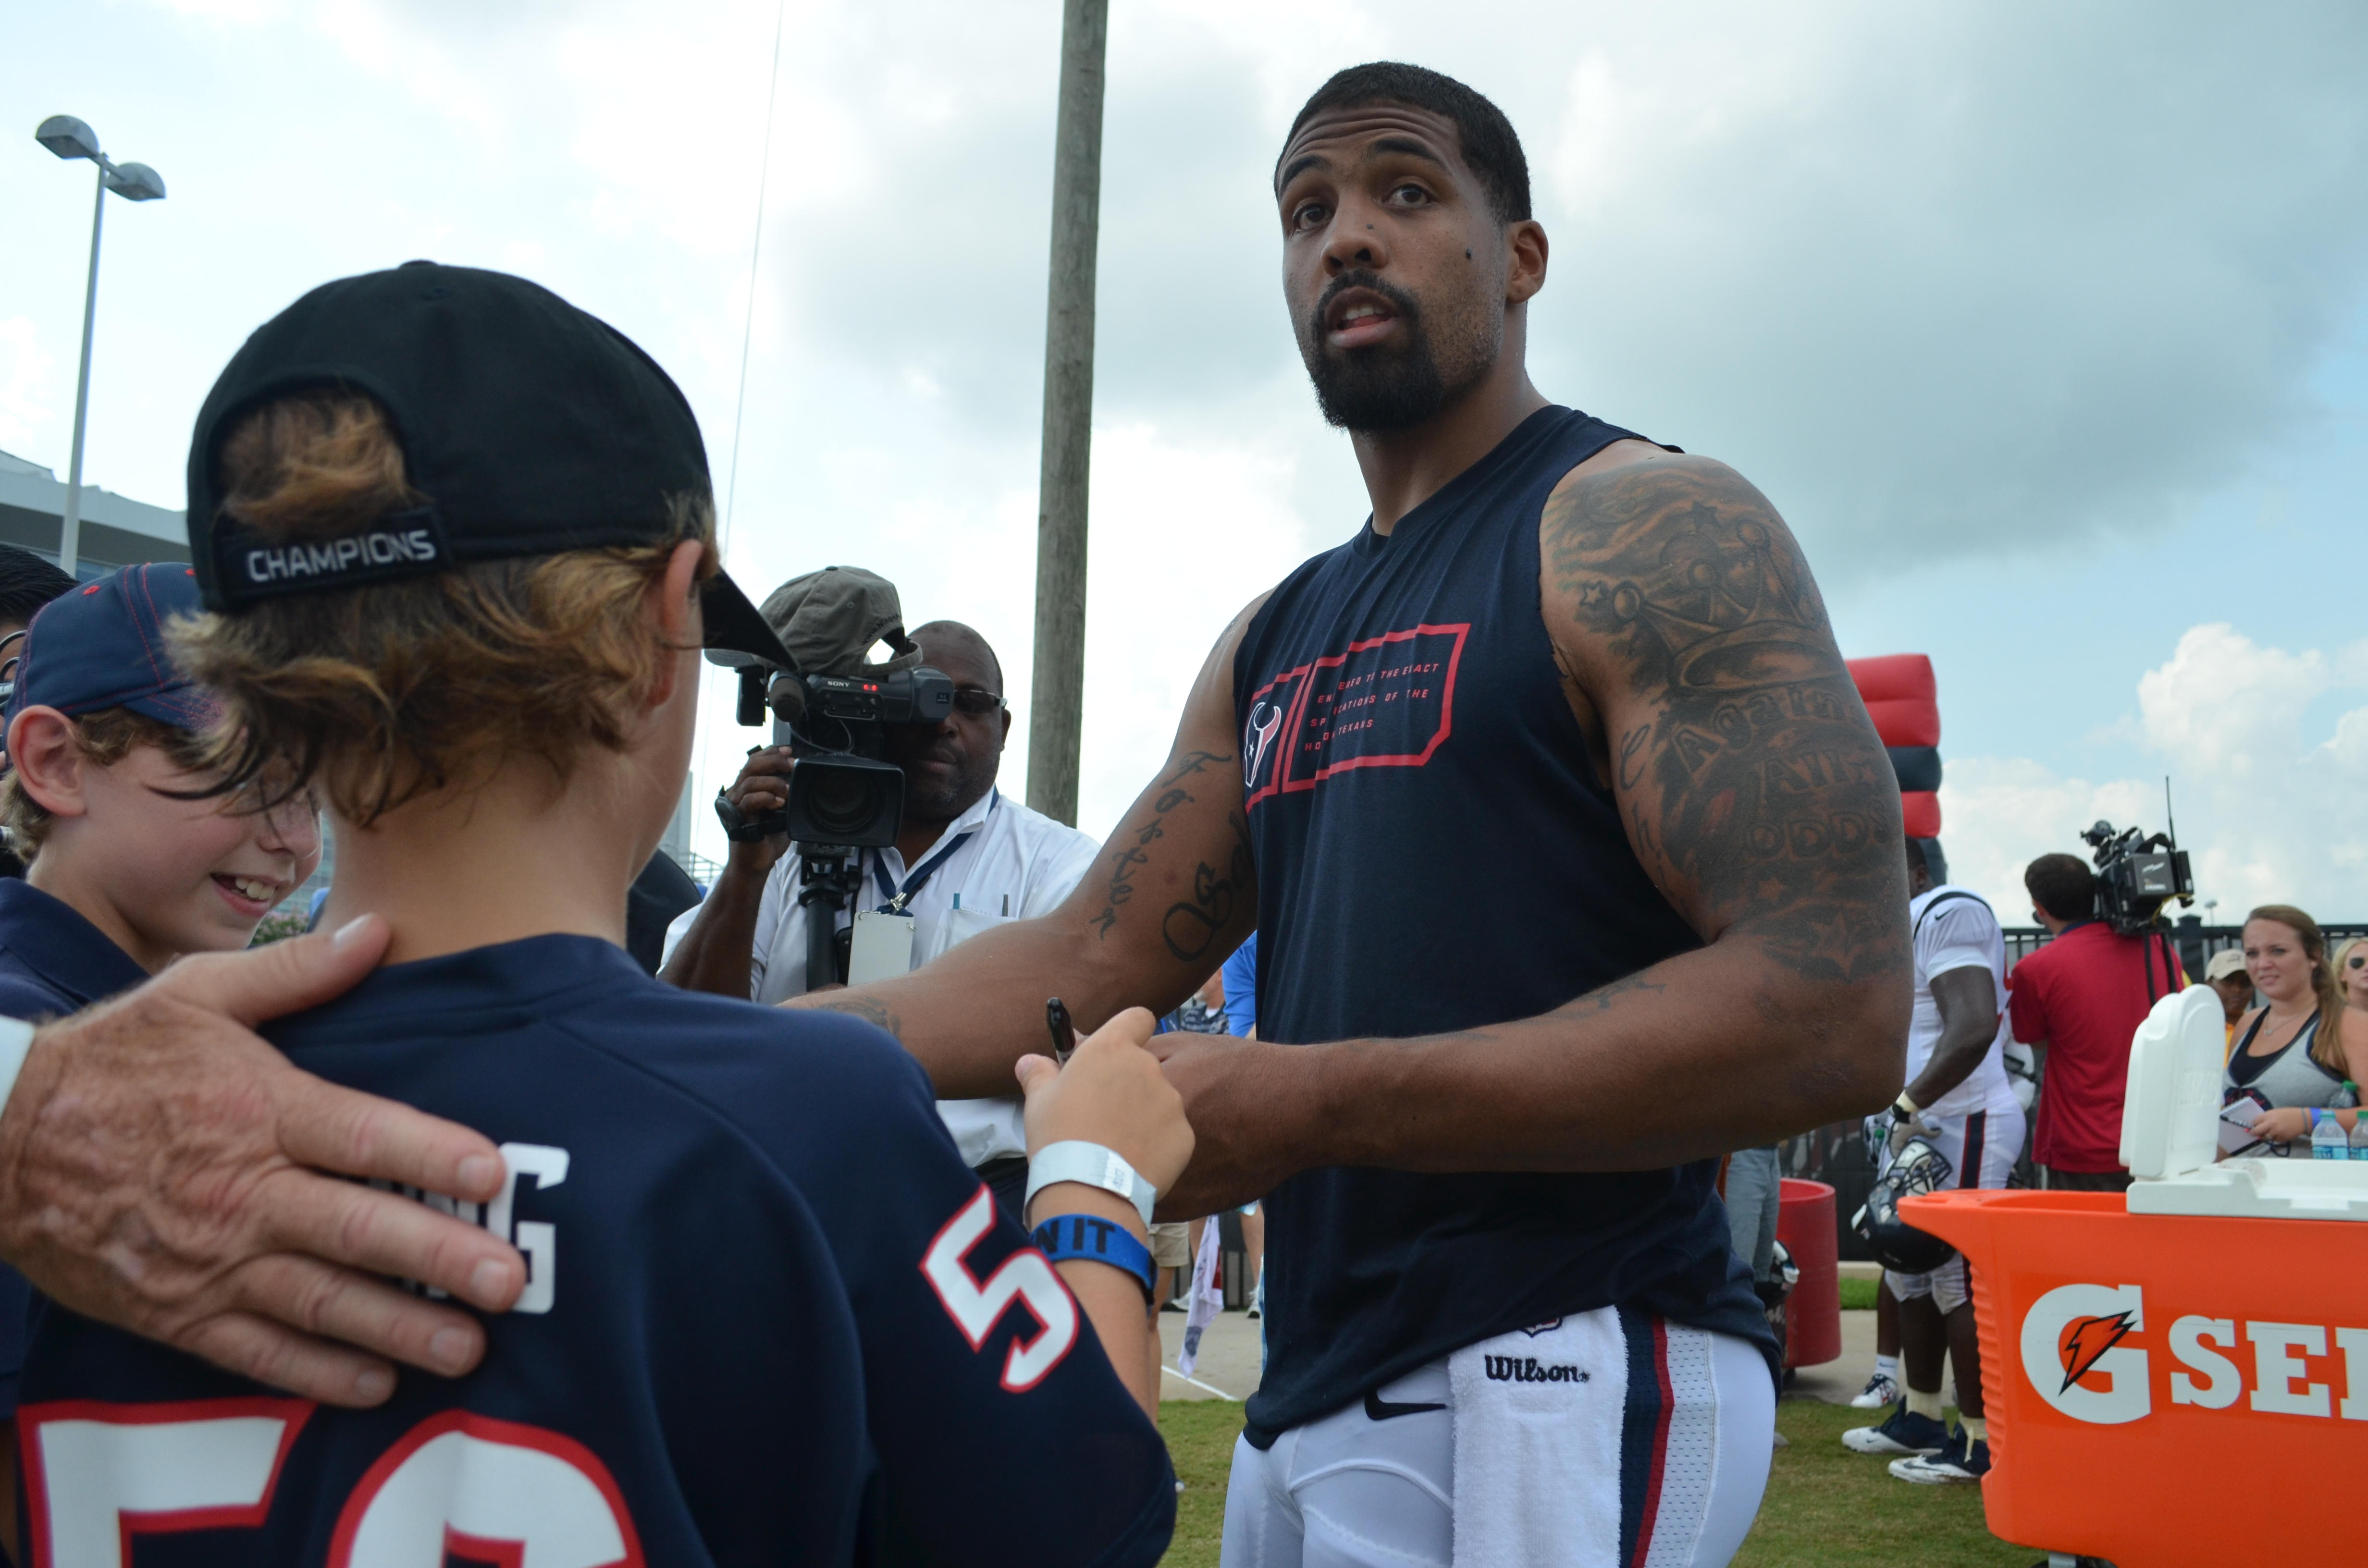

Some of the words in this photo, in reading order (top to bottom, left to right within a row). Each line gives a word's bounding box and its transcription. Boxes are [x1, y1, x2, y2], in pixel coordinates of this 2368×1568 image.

[248, 530, 435, 582] CHAMPIONS
[1381, 668, 1399, 679] THE
[1385, 692, 1398, 702] OF
[1338, 719, 1374, 735] TEXANS
[1073, 1218, 1115, 1253] IT
[919, 1182, 1080, 1393] 5
[2020, 1283, 2151, 1424] G
